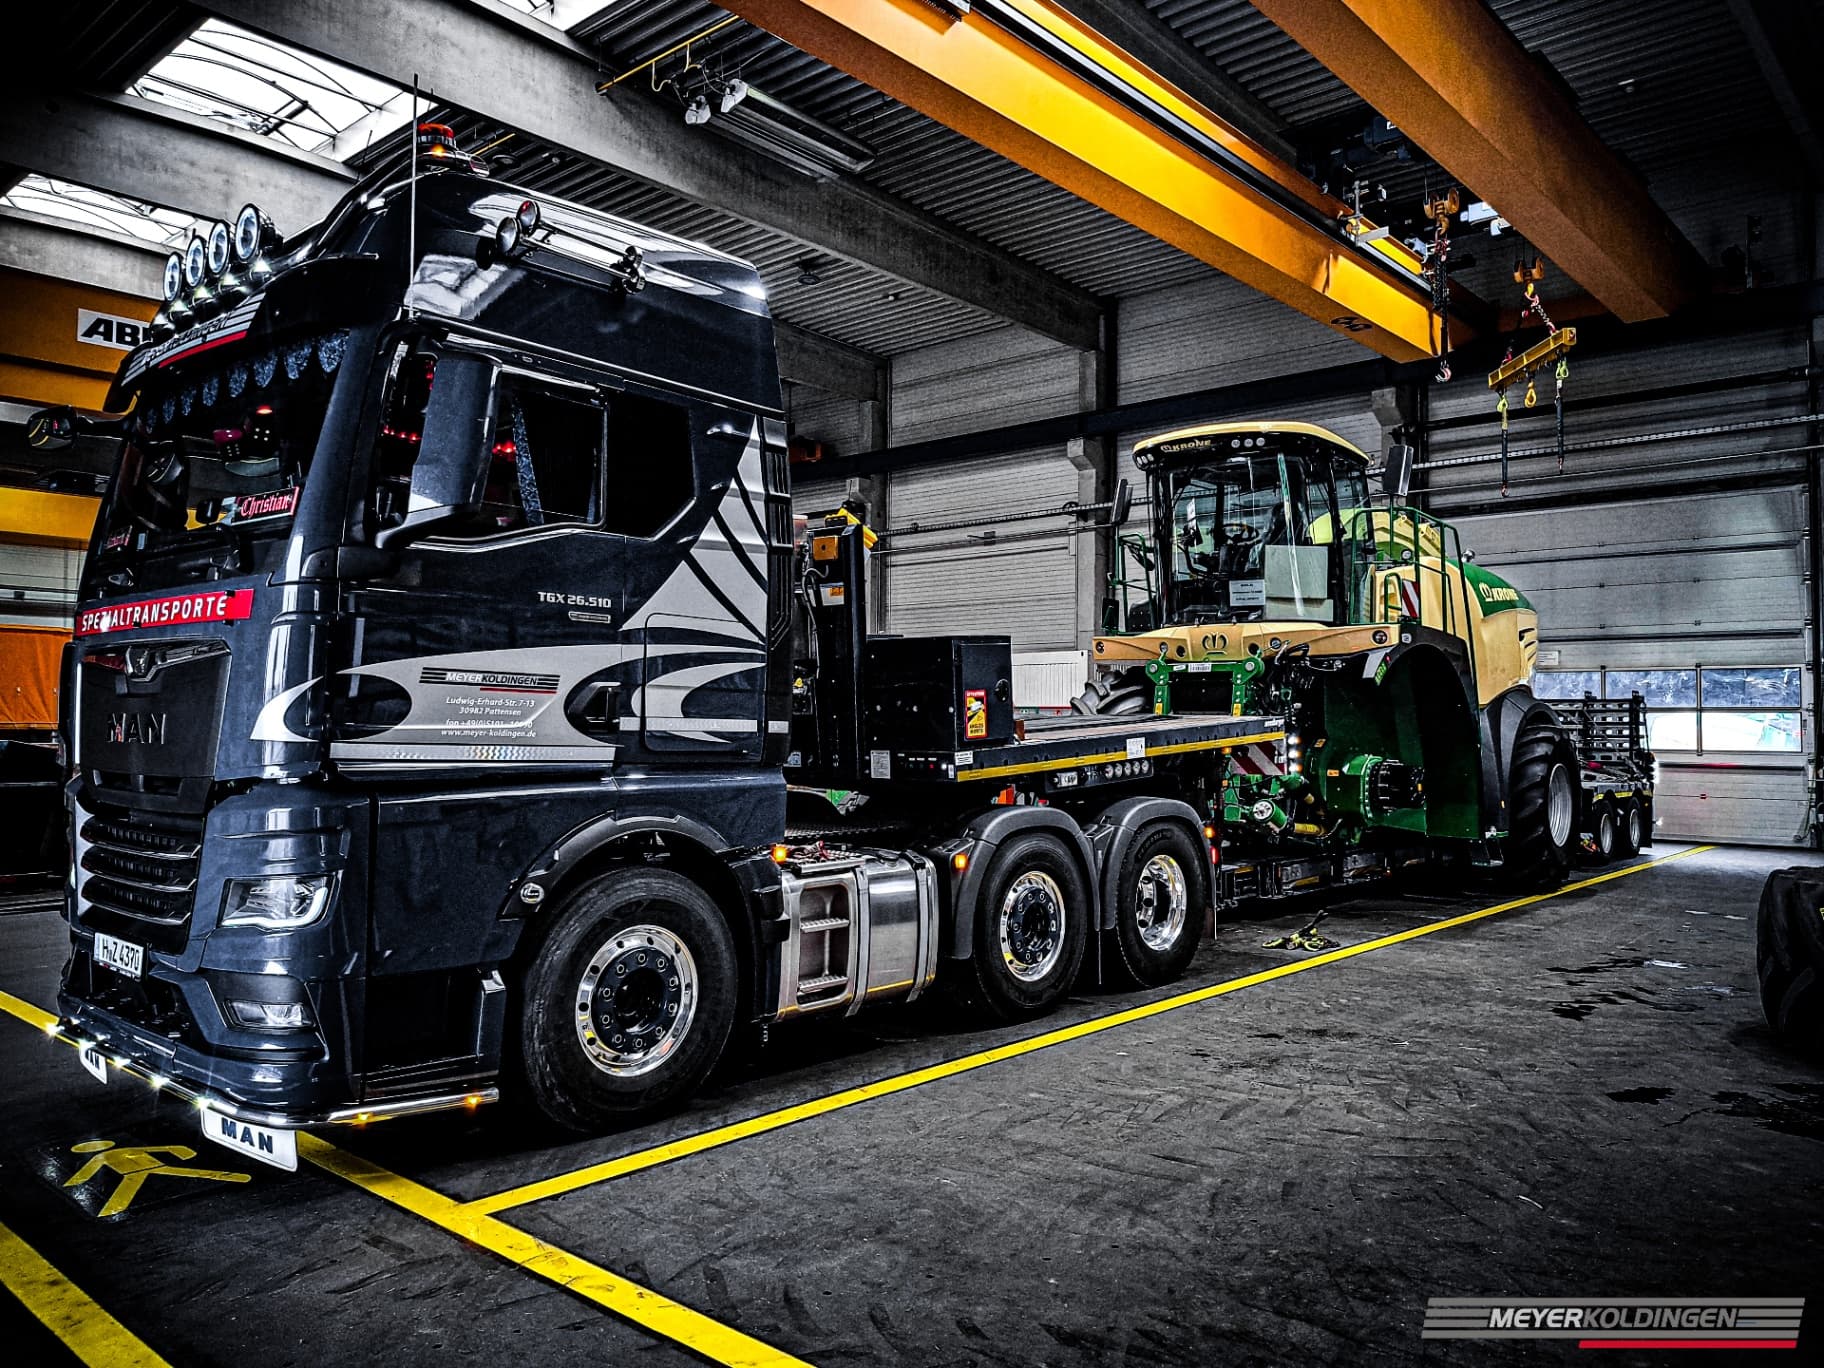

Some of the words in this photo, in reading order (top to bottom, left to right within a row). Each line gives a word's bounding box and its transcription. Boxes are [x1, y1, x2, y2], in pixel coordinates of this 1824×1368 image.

[81, 317, 153, 347] AB
[241, 492, 290, 517] Christian
[537, 591, 566, 604] TGX
[567, 594, 612, 608] 26.510
[445, 672, 538, 685] MEYERKOLDINGEN
[445, 696, 517, 707] Ludwig-Erhard-Str.
[485, 707, 522, 716] Pattensen
[106, 712, 167, 744] MAN
[441, 728, 537, 738] www.meyer-koldingen.de
[221, 1117, 274, 1155] MAN
